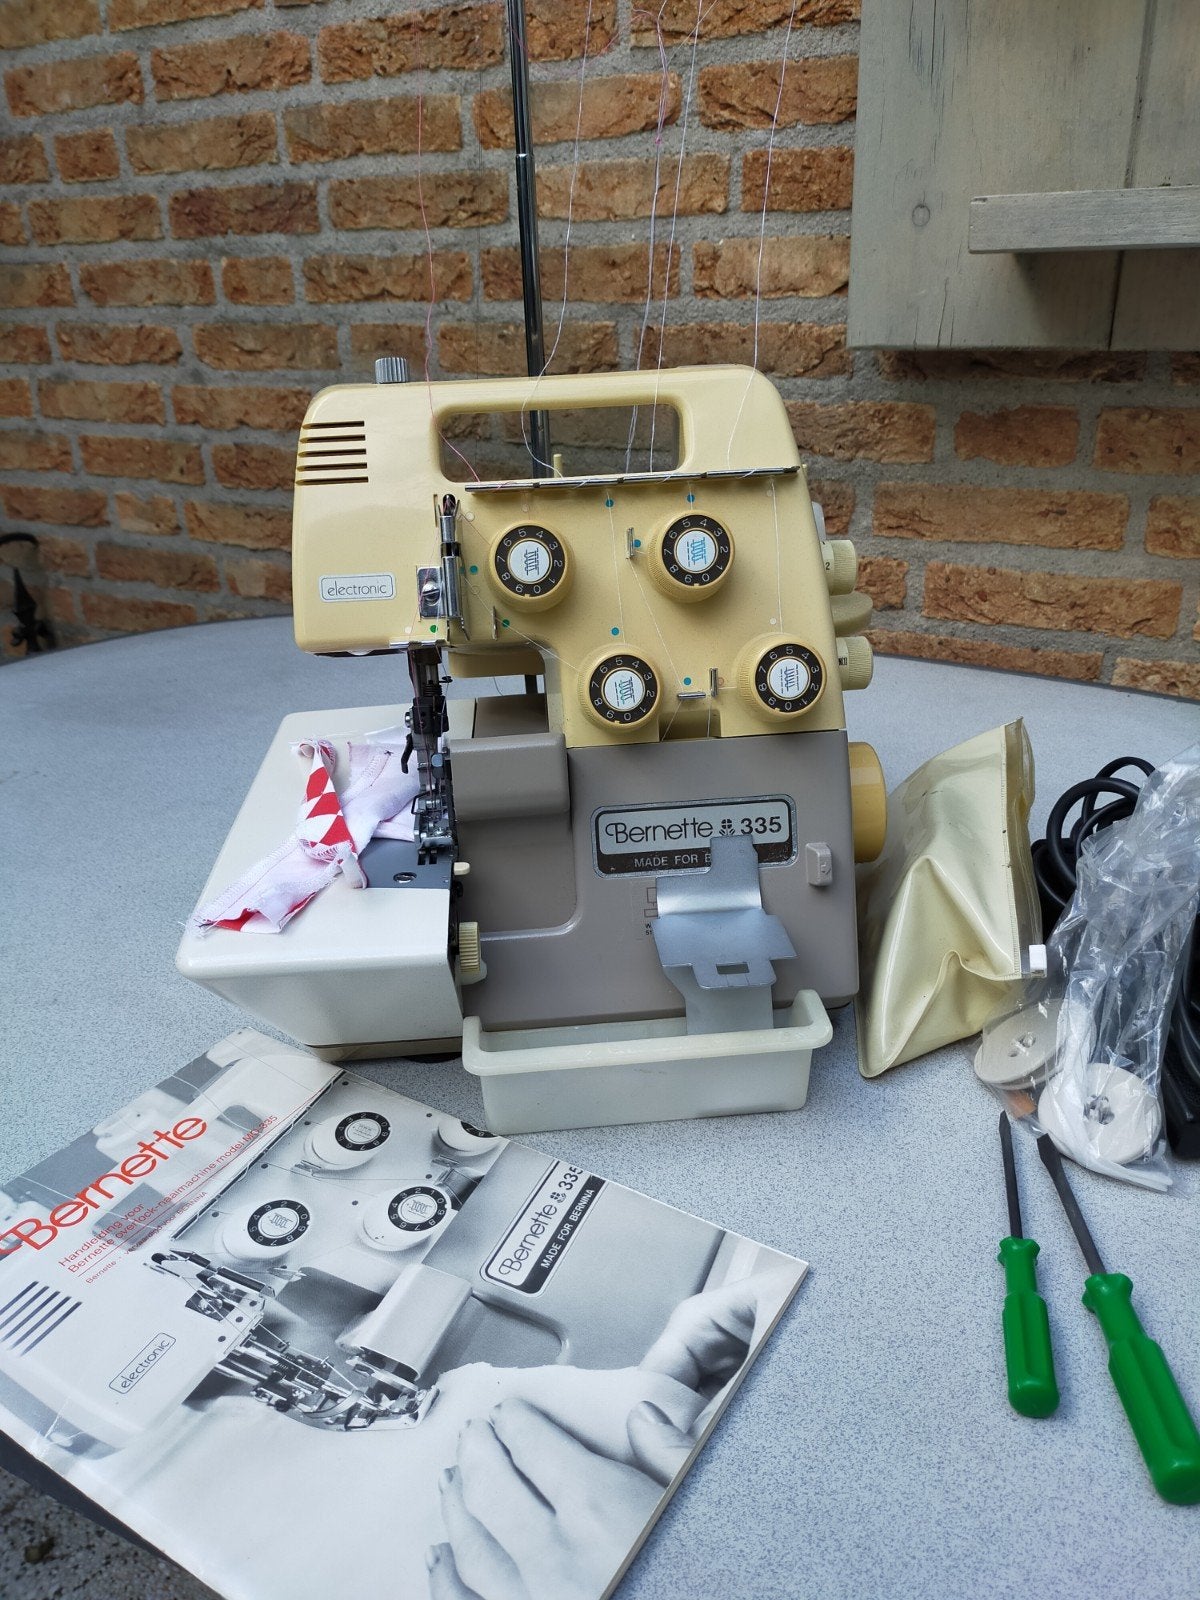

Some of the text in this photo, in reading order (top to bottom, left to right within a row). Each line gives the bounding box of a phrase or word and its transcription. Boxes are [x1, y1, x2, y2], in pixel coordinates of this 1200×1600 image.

[682, 519, 690, 527] 5
[518, 529, 526, 537] 5
[669, 530, 677, 538] 6
[714, 528, 722, 537] 3
[503, 538, 511, 547] 6
[549, 542, 558, 550] 3
[826, 562, 830, 570] 2
[502, 572, 510, 580] 8
[328, 580, 386, 596] electronic
[534, 585, 541, 593] 0
[616, 657, 623, 665] 5
[600, 665, 608, 673] 6
[759, 683, 767, 691] 8
[810, 683, 819, 691] 2
[594, 698, 603, 706] 8
[785, 702, 792, 710] 0
[605, 816, 782, 844] Bernette 335
[634, 856, 668, 868] MADE
[675, 854, 698, 864] FOR
[0, 1117, 207, 1256] Bernette
[68, 1239, 114, 1272] Bernette
[116, 1162, 216, 1238] overlock-naaimachine
[216, 1142, 244, 1164] model
[540, 1189, 595, 1268] MADE FOR BERNINA
[58, 1203, 144, 1266] Handleiding voor
[498, 1204, 558, 1275] Bernette
[86, 1260, 116, 1284] Bernette
[121, 1340, 170, 1388] electronic
